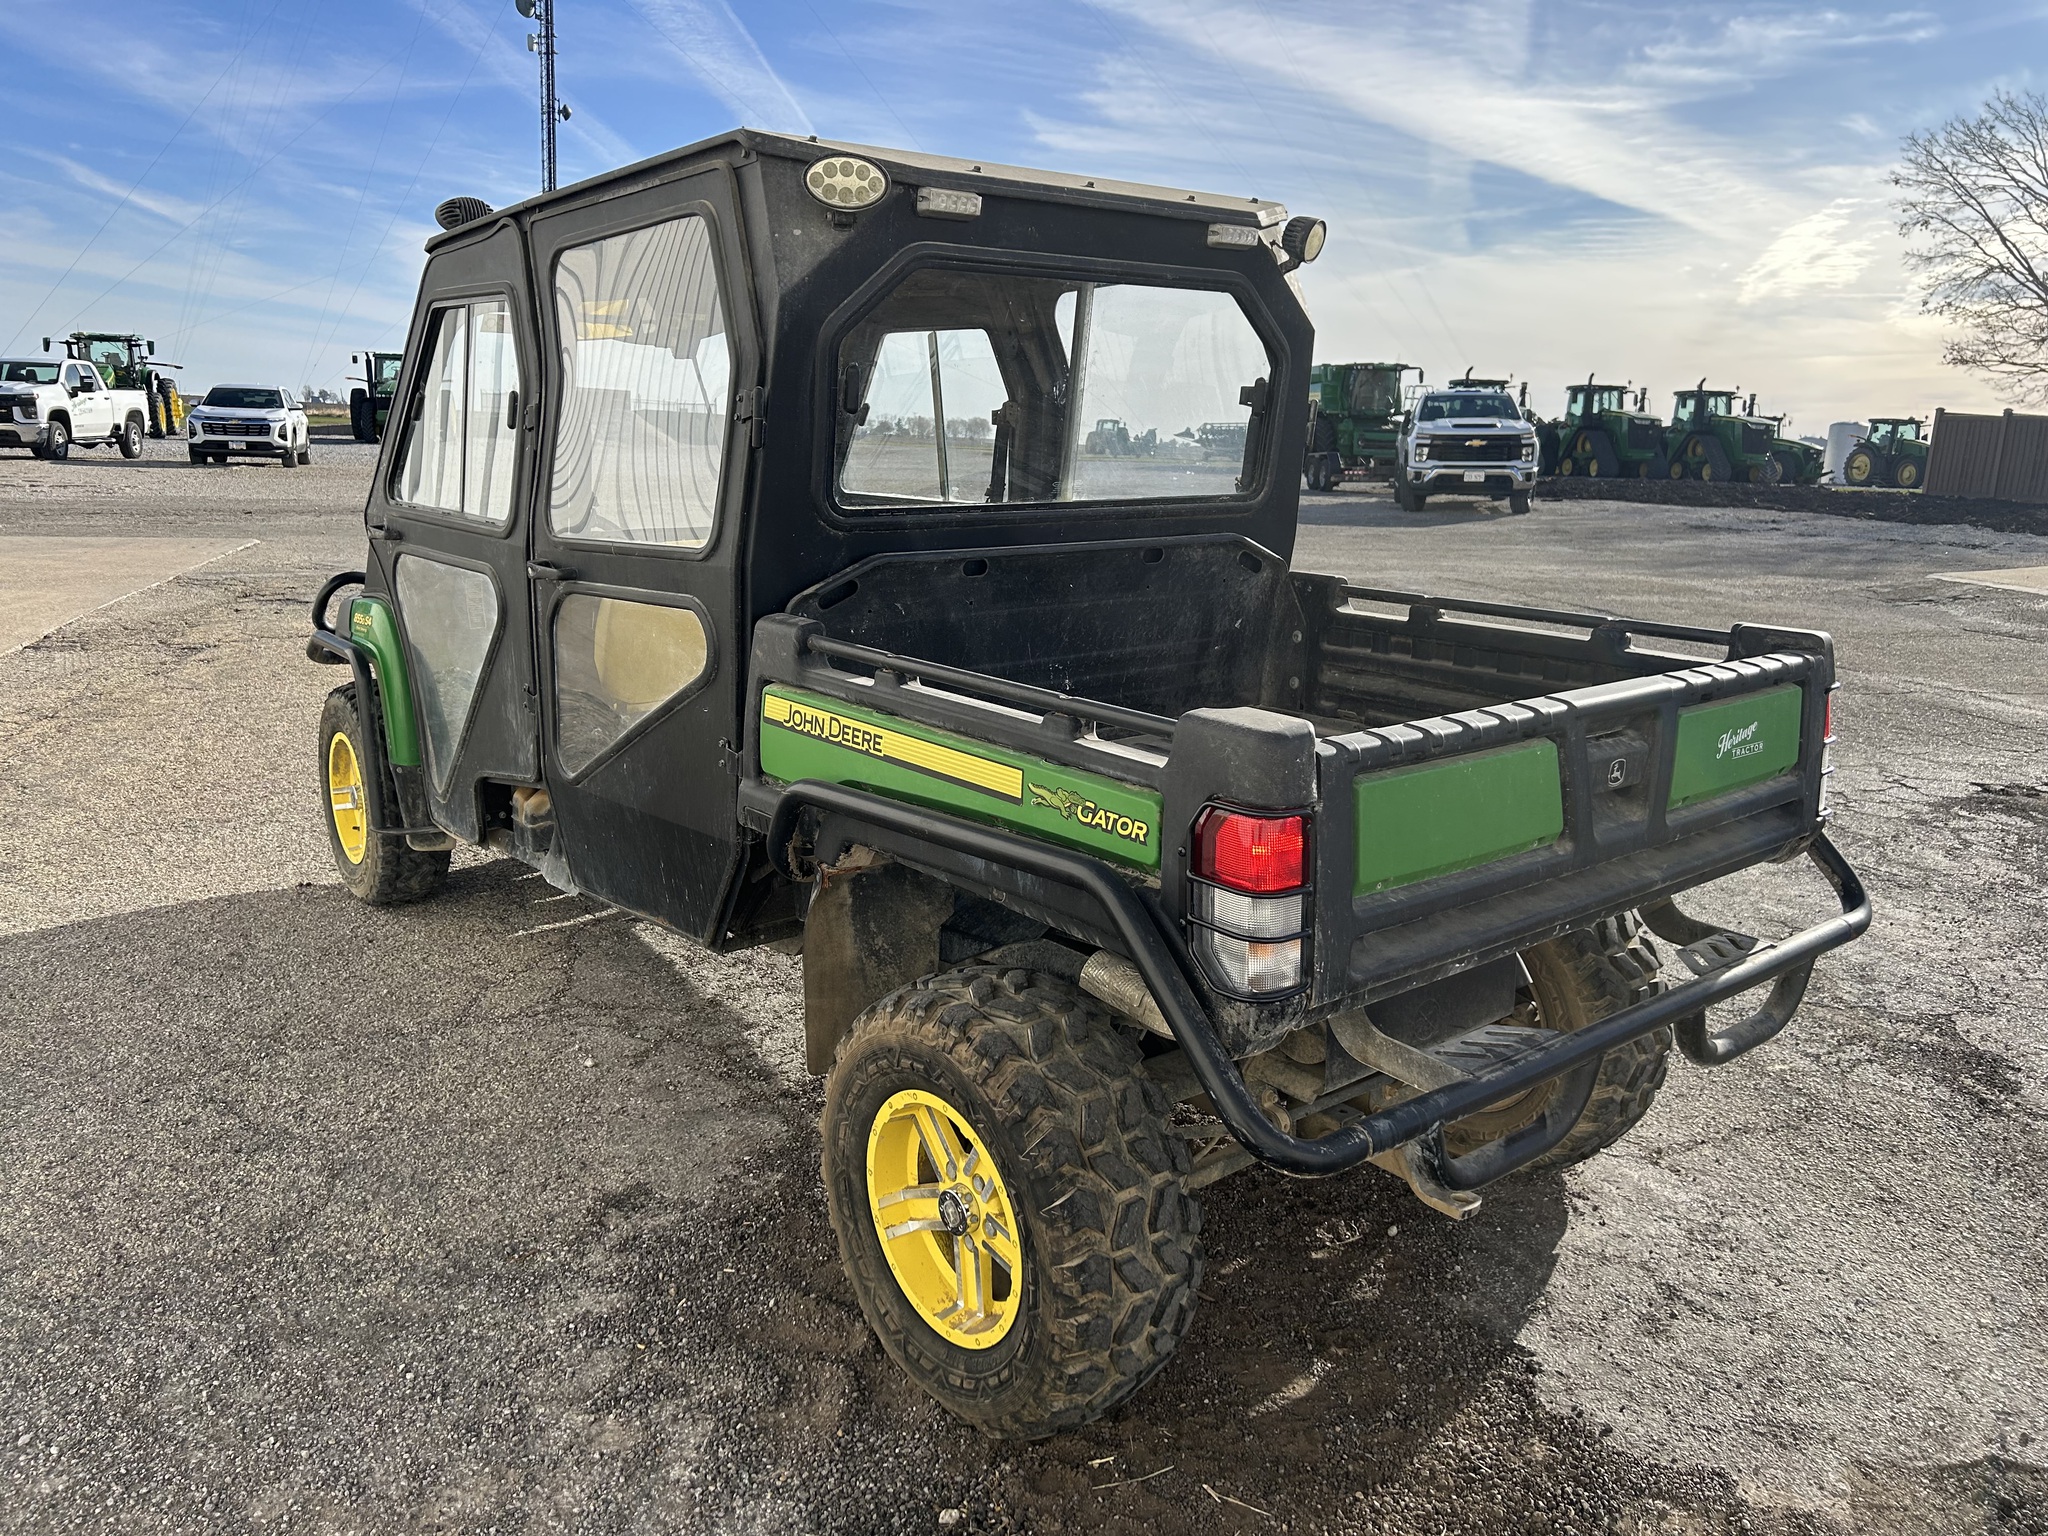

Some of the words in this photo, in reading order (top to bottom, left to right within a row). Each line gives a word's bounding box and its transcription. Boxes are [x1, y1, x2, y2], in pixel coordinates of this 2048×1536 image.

[783, 704, 825, 736] JOHN
[828, 716, 883, 754] DEERE
[1716, 721, 1758, 759] Heritage
[1731, 742, 1764, 758] TRACTOR
[1076, 800, 1149, 845] GATOR
